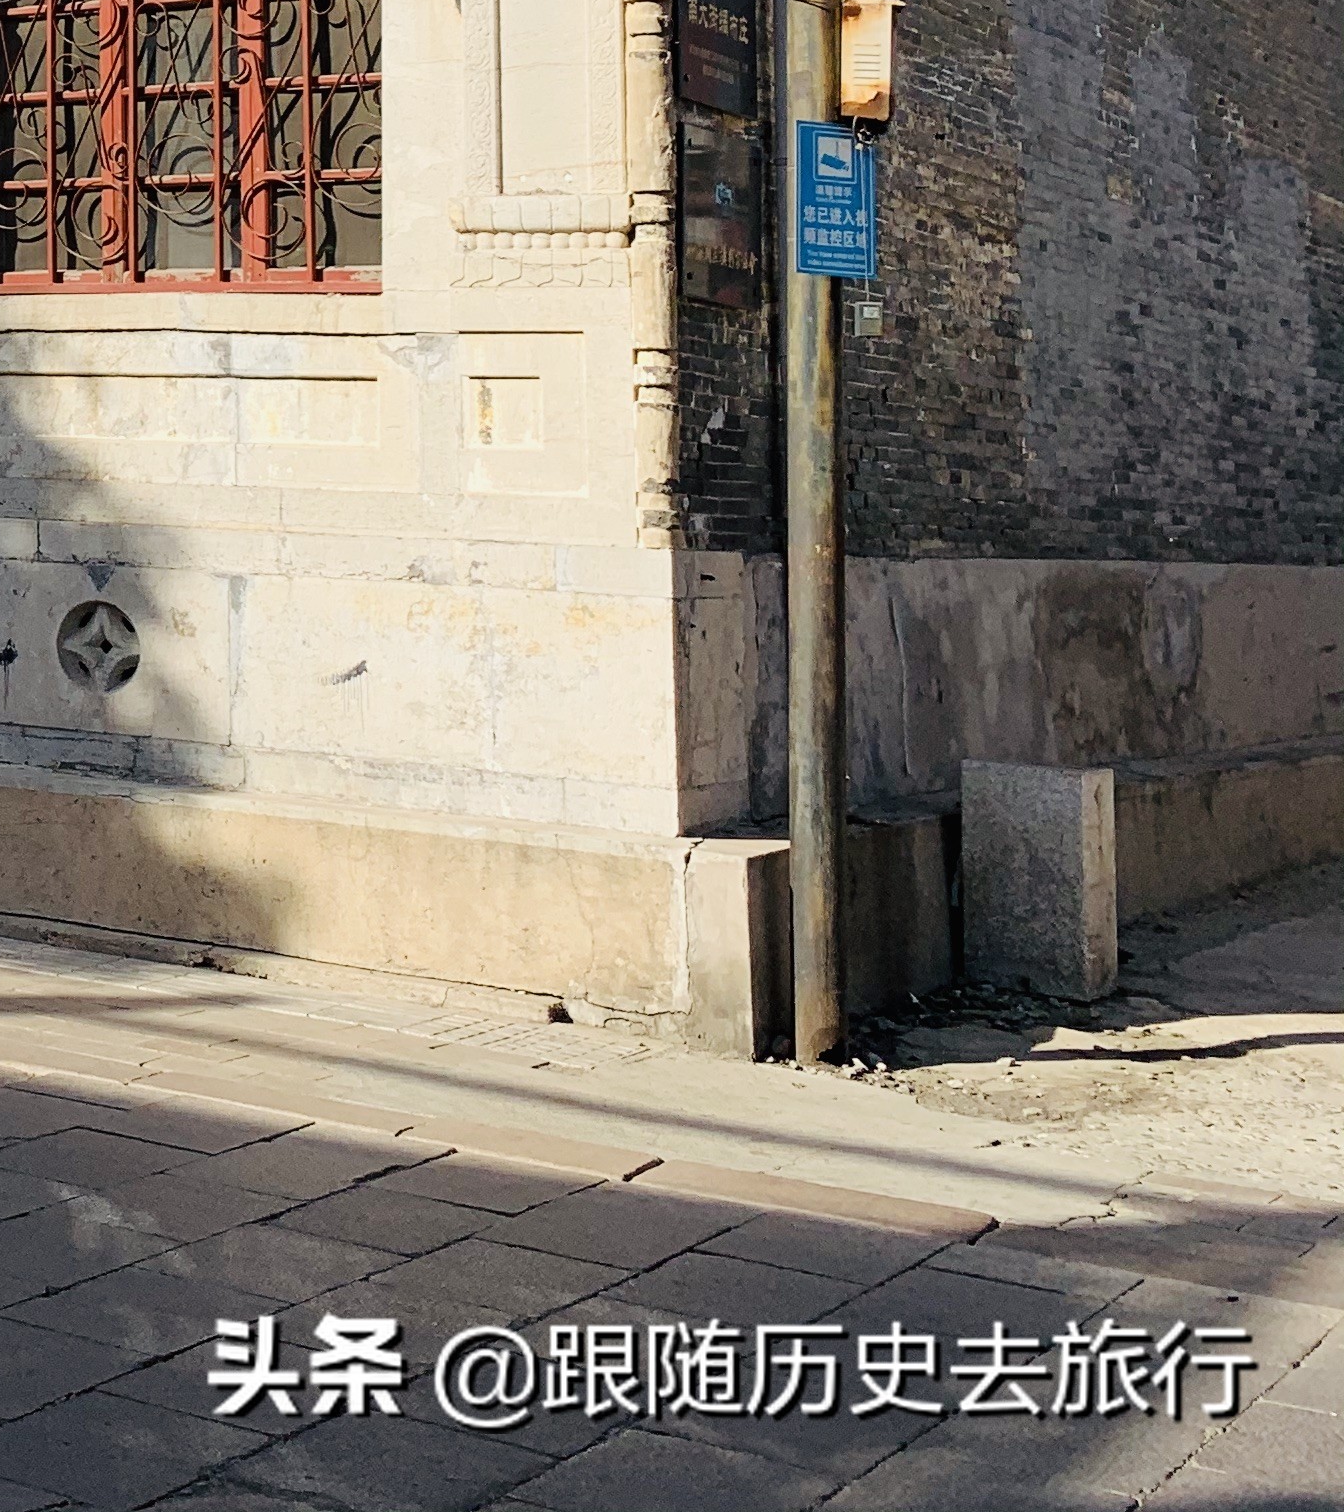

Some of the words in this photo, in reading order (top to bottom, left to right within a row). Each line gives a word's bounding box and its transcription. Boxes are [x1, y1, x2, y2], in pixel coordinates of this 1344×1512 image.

[803, 204, 869, 228] 您已进入视
